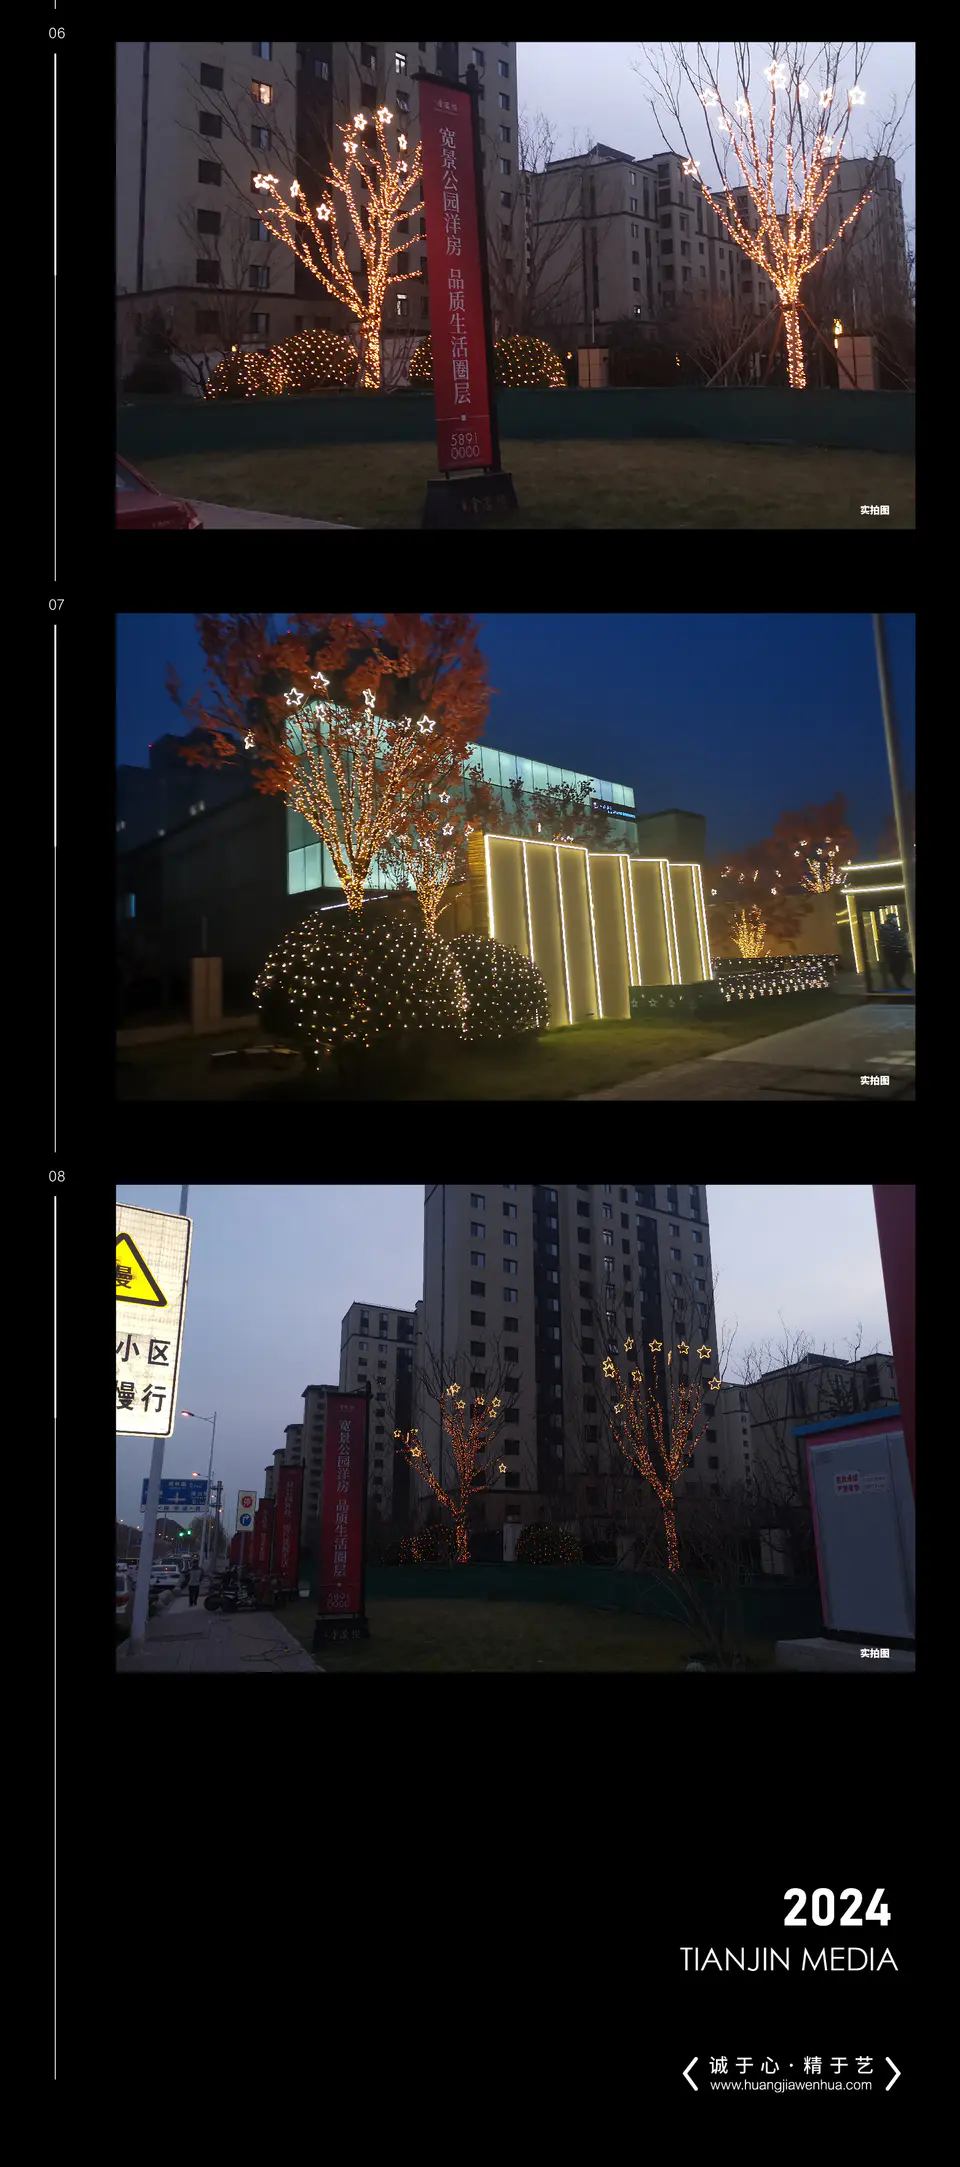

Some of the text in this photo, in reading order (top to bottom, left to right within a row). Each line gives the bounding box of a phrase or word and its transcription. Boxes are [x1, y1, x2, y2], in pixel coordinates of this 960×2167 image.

[438, 127, 461, 257] 宽景公园洋房
[448, 268, 471, 405] 品质生活圈层
[451, 432, 478, 447] 5891
[451, 445, 480, 460] 0000
[116, 1334, 171, 1367] 小区
[336, 1419, 351, 1493] 宽景公园洋房
[333, 1500, 349, 1578] 品质生活圈层
